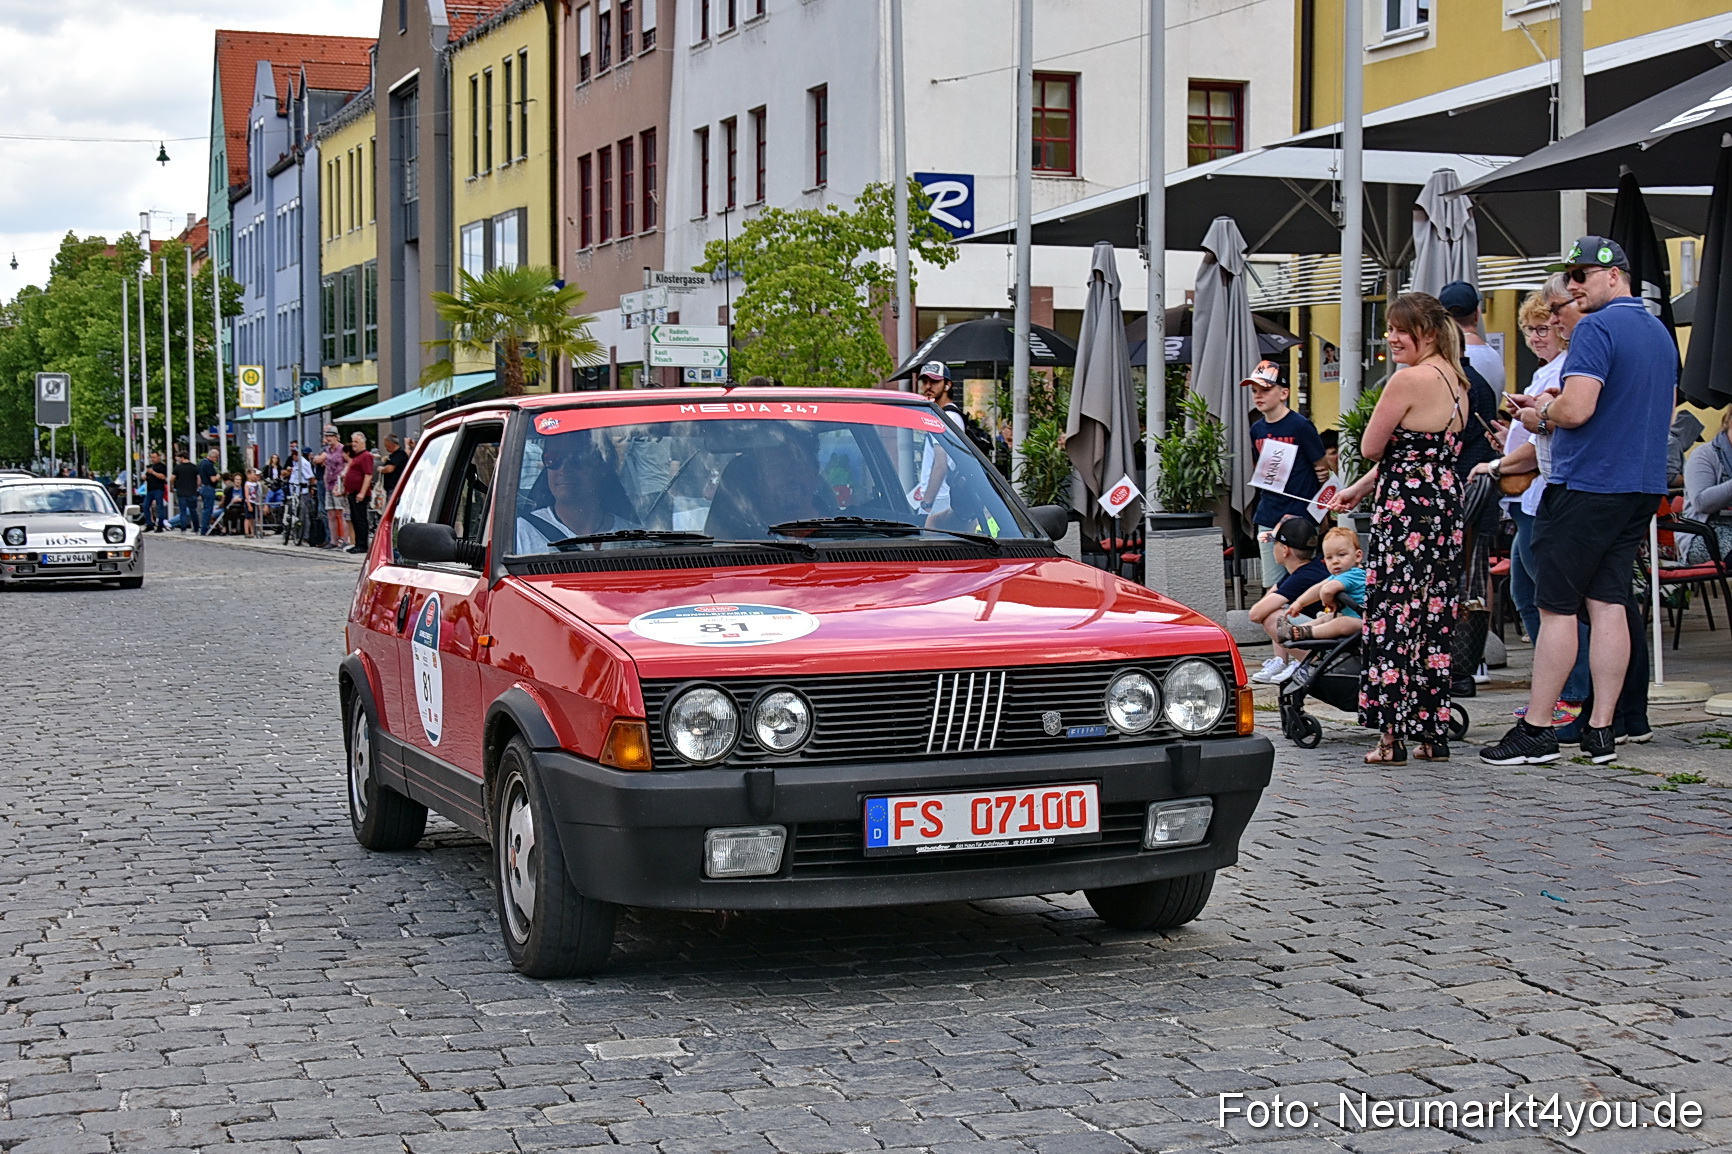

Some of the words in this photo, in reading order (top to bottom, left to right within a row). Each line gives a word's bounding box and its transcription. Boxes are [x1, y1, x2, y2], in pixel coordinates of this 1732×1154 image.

[655, 273, 705, 286] Klostergasse
[680, 403, 772, 414] MEDIA
[781, 404, 819, 414] 247
[47, 554, 61, 563] SLF
[72, 554, 86, 562] 944
[700, 623, 749, 633] 81
[422, 671, 433, 704] 81
[894, 800, 943, 840] FS
[971, 790, 1086, 835] 07100
[873, 828, 882, 840] D
